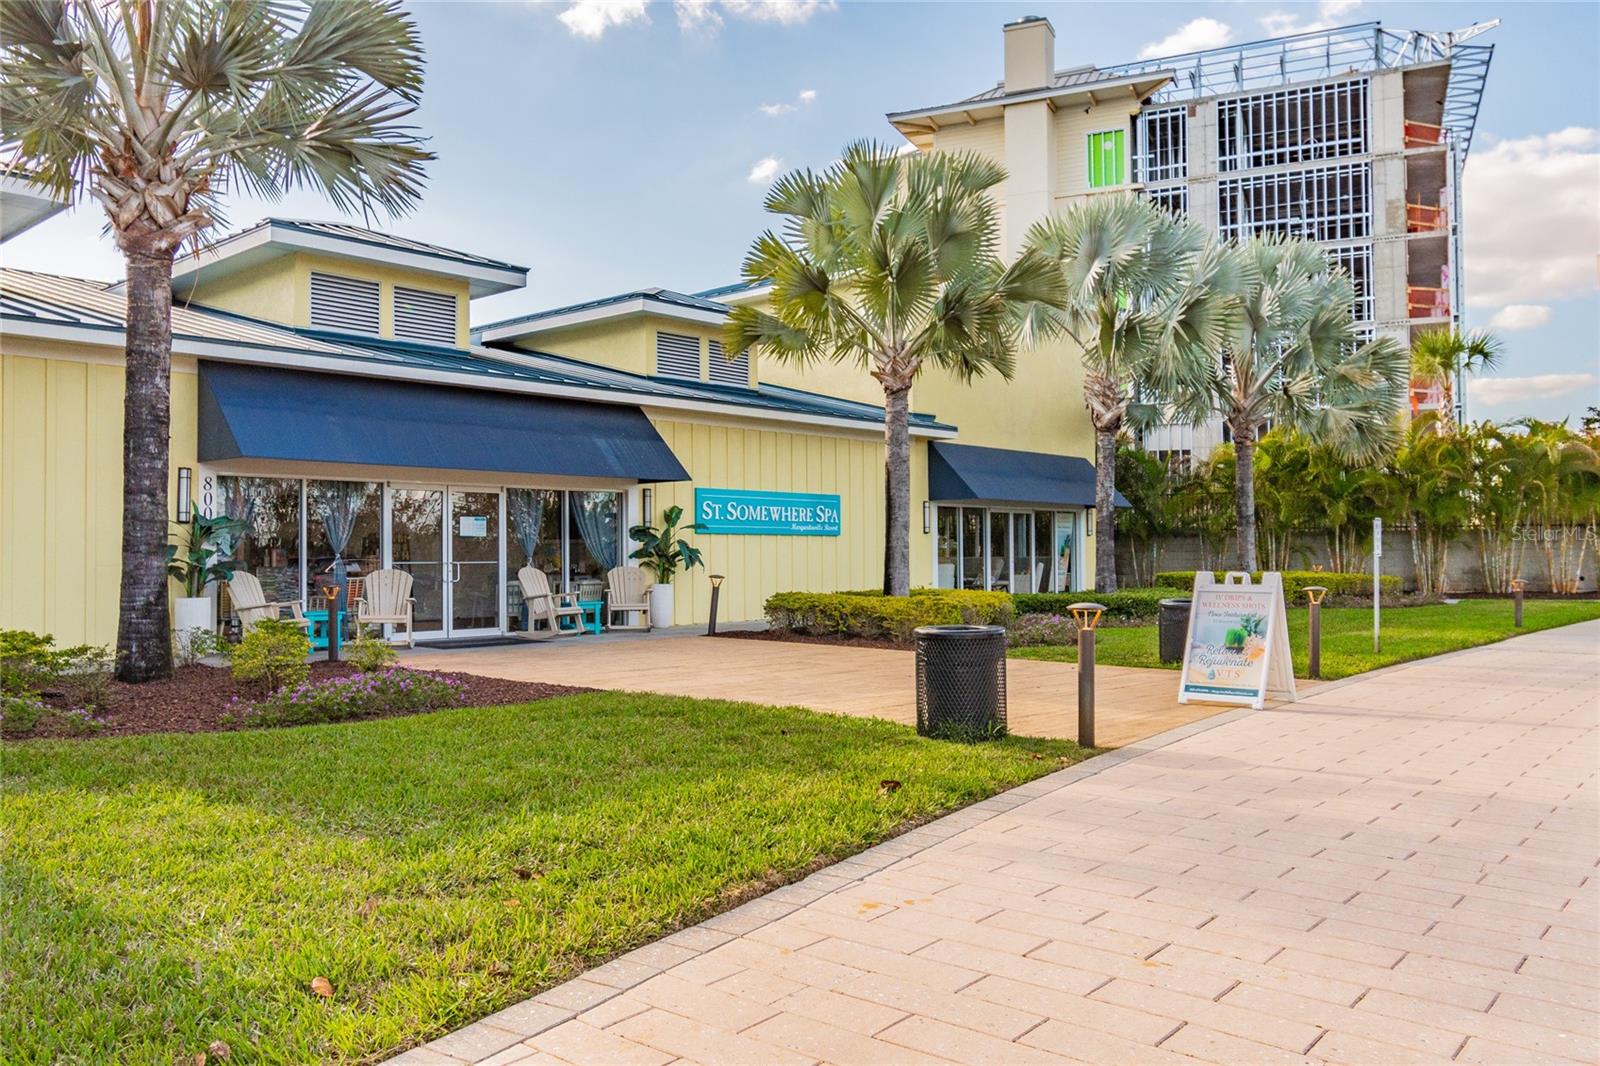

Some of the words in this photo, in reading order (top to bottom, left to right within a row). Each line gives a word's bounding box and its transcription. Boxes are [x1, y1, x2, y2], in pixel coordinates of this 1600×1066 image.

[727, 502, 814, 522] SOMEWHERE
[816, 505, 839, 523] SPA
[1198, 655, 1254, 668] Rejuvenate
